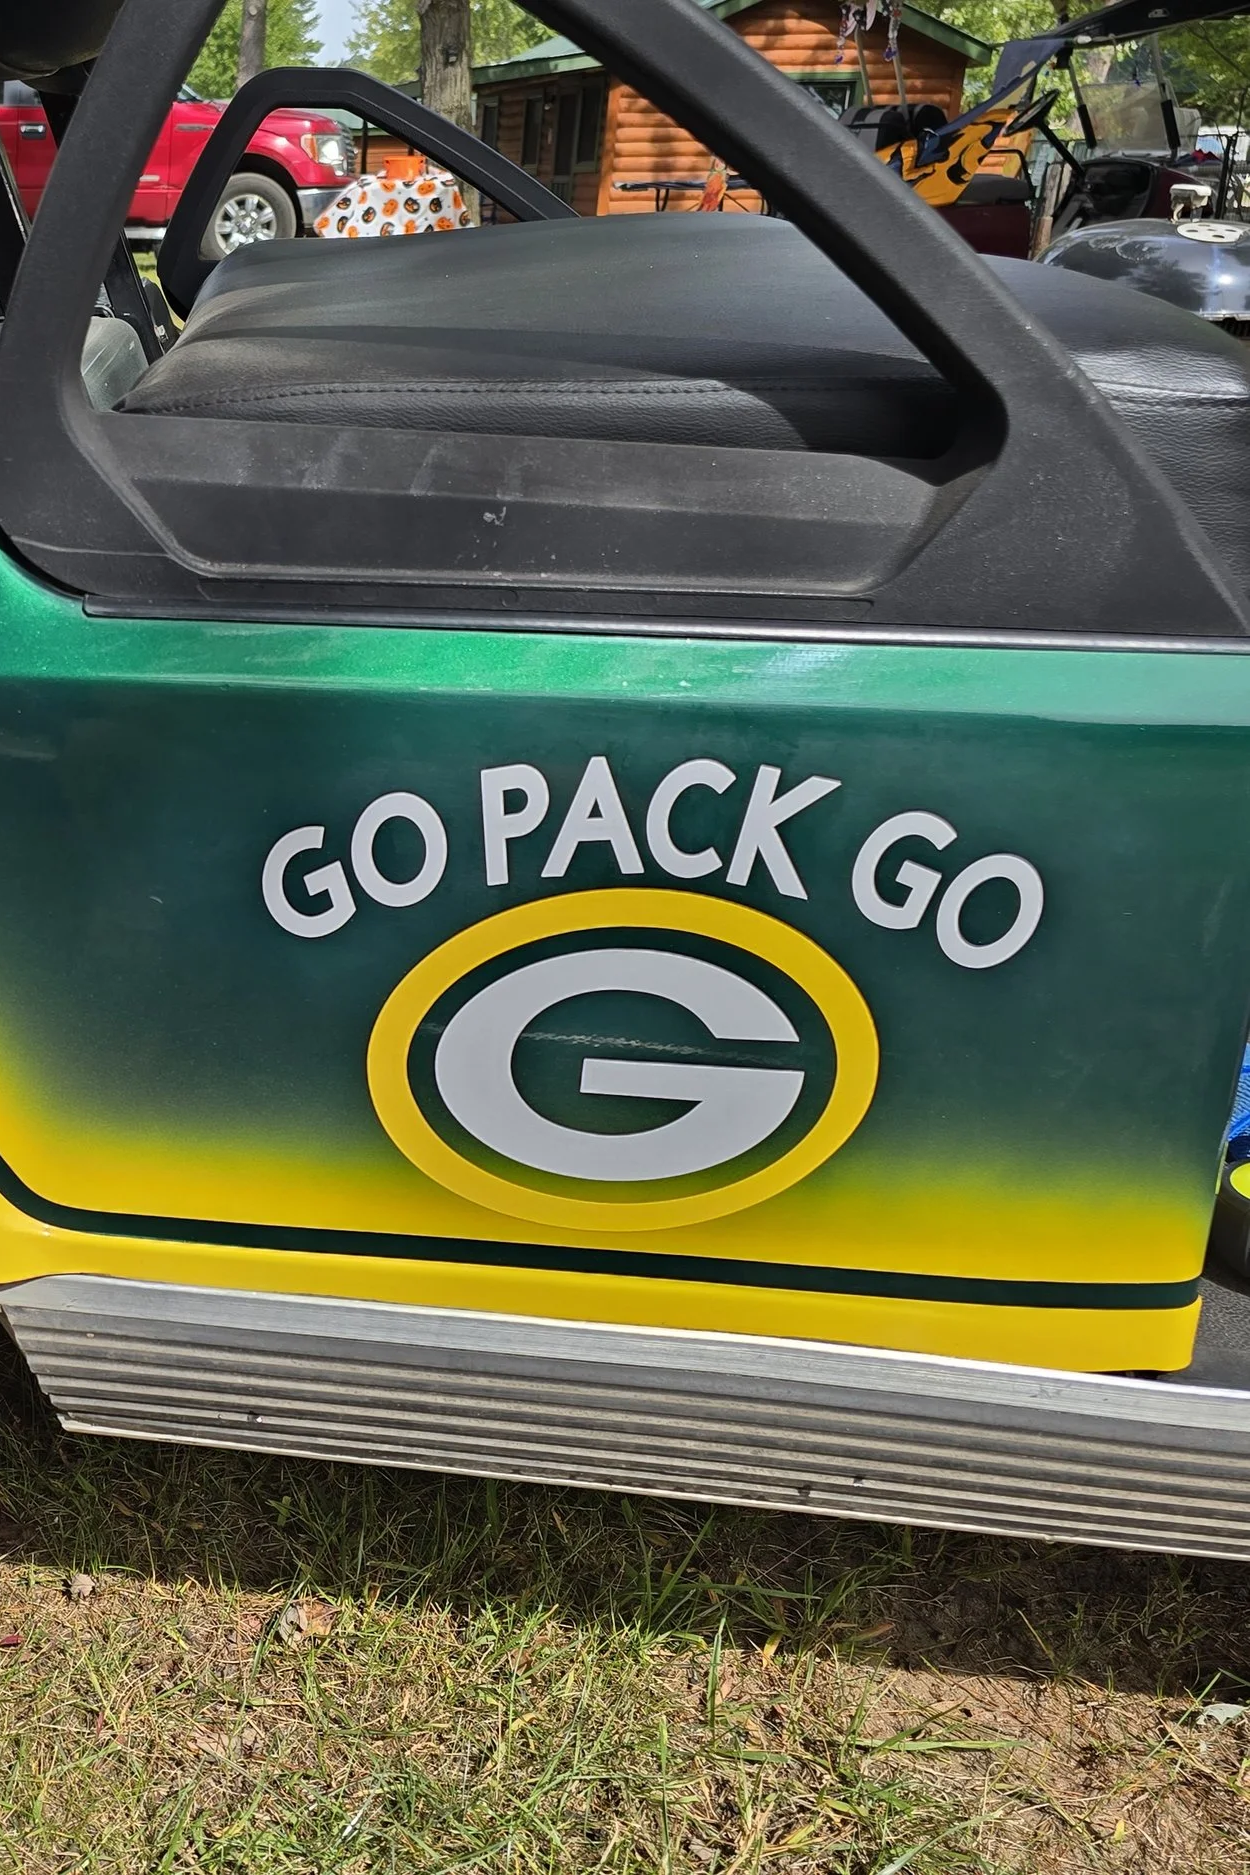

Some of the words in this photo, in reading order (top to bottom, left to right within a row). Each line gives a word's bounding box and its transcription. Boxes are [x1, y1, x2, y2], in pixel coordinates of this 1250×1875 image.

[262, 791, 448, 938] GO
[481, 756, 842, 900] PACK
[852, 810, 1044, 969] GO
[434, 948, 806, 1182] G
